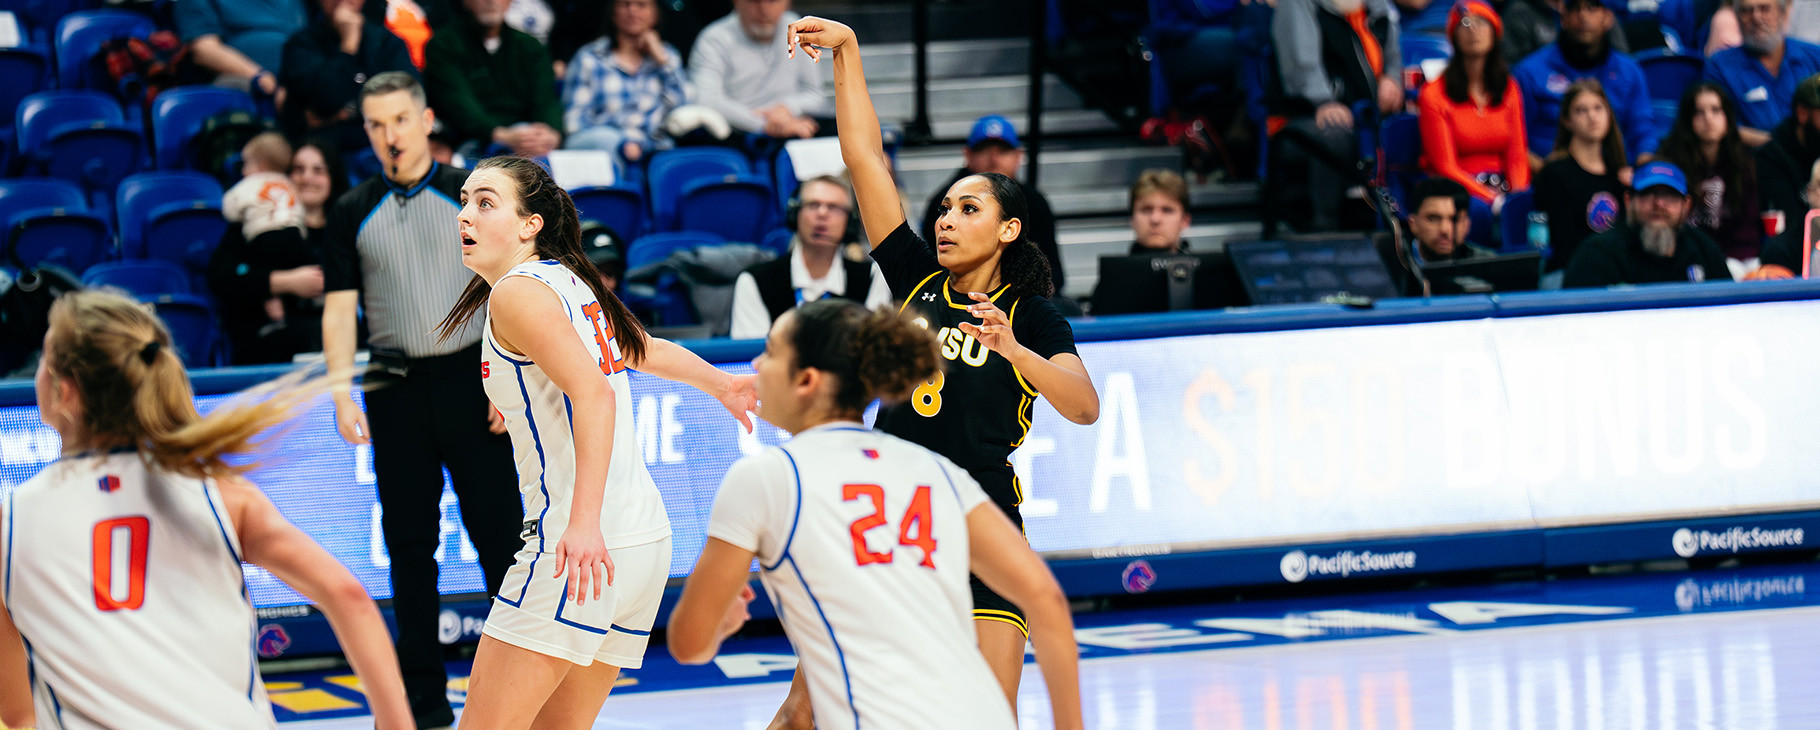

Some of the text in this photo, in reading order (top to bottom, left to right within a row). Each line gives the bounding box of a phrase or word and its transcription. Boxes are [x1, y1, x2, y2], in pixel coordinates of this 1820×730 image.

[1183, 360, 1406, 506] $150
[1442, 335, 1768, 489] BONUS
[91, 515, 150, 612] 0
[841, 484, 937, 569] 24
[1309, 550, 1417, 578] PacificSource
[1700, 526, 1805, 554] PacificSource
